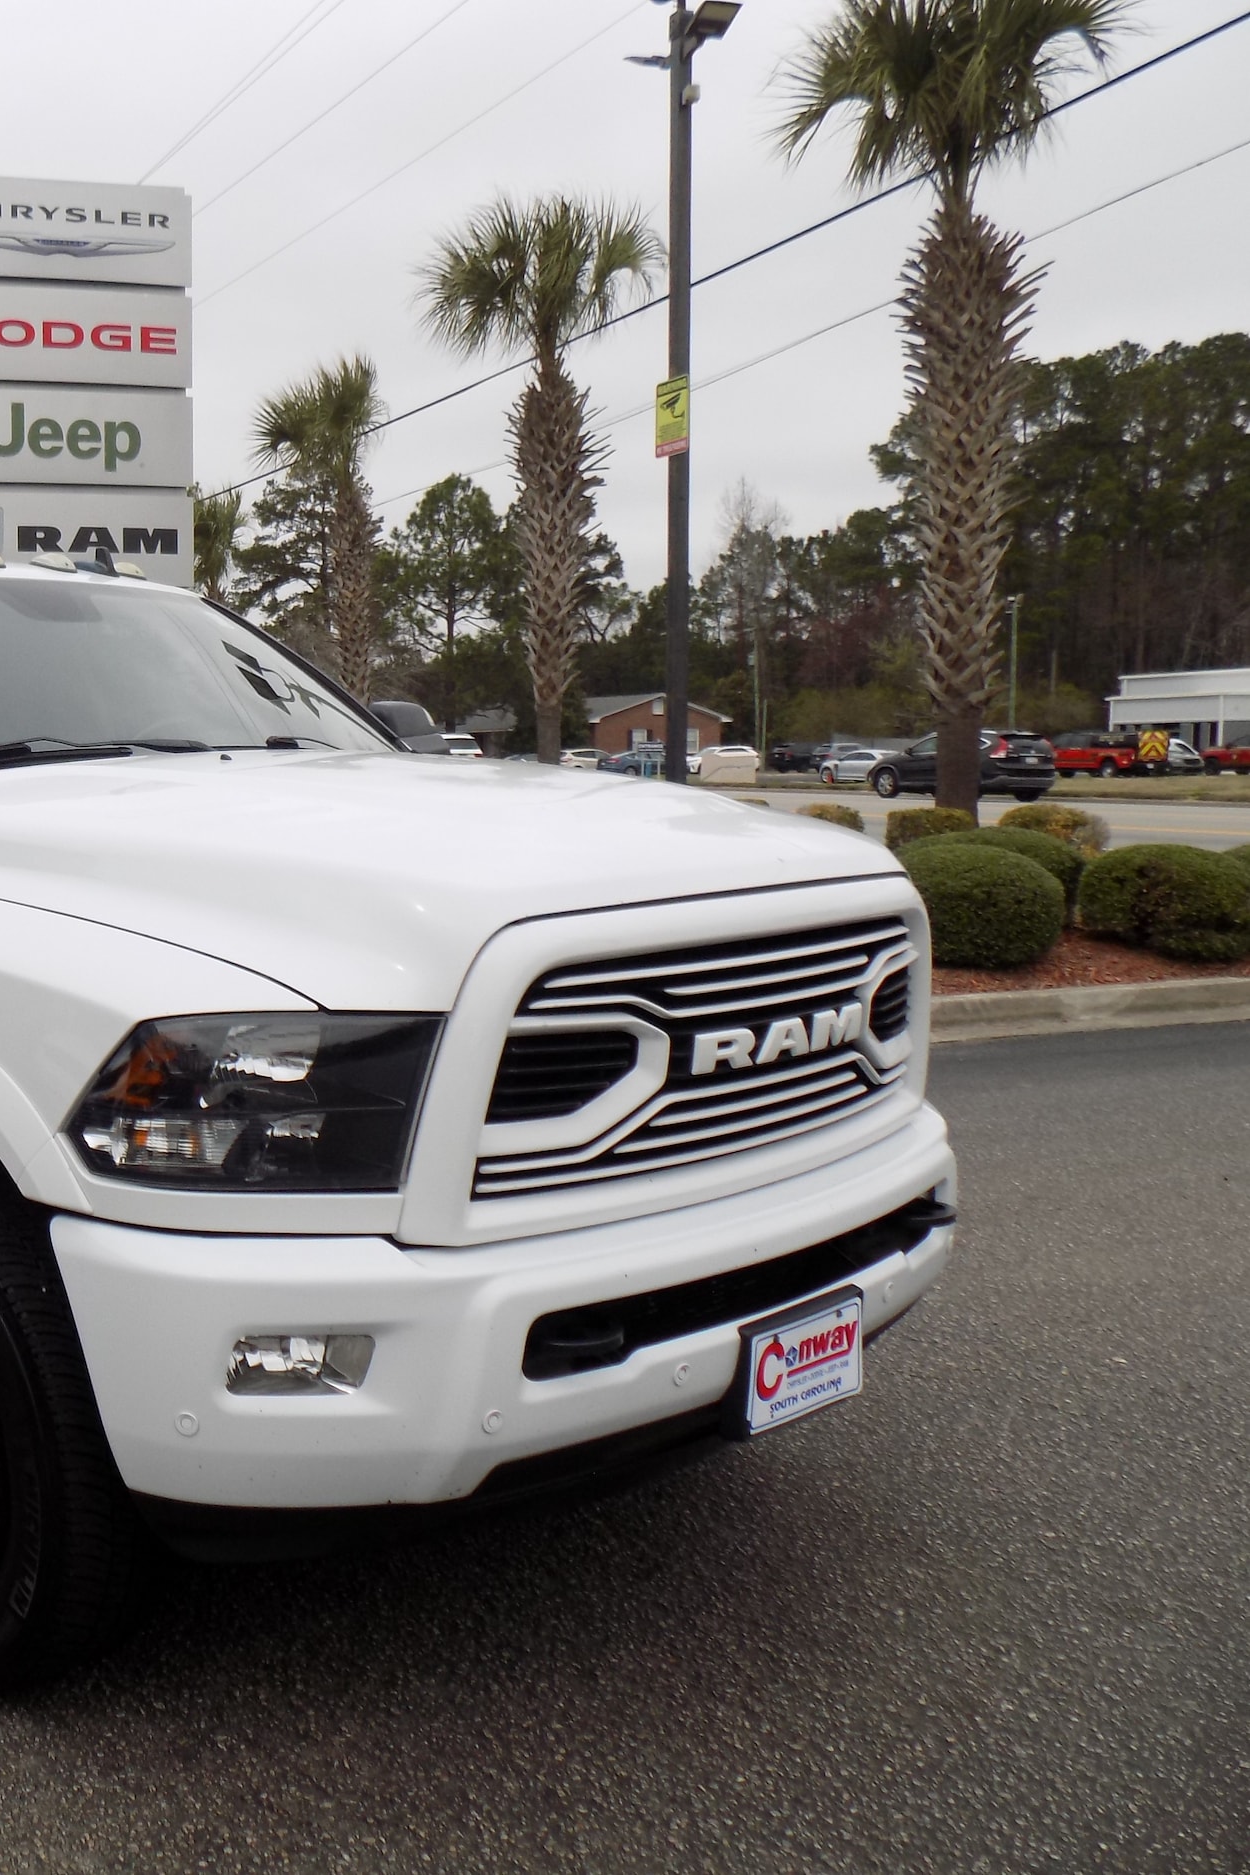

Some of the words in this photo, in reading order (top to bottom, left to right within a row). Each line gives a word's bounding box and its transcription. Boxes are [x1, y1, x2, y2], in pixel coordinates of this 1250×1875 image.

[17, 526, 178, 555] RAM
[691, 1002, 862, 1076] RAM
[770, 1393, 798, 1413] SOUTH
[801, 1376, 843, 1401] CAROLINA
